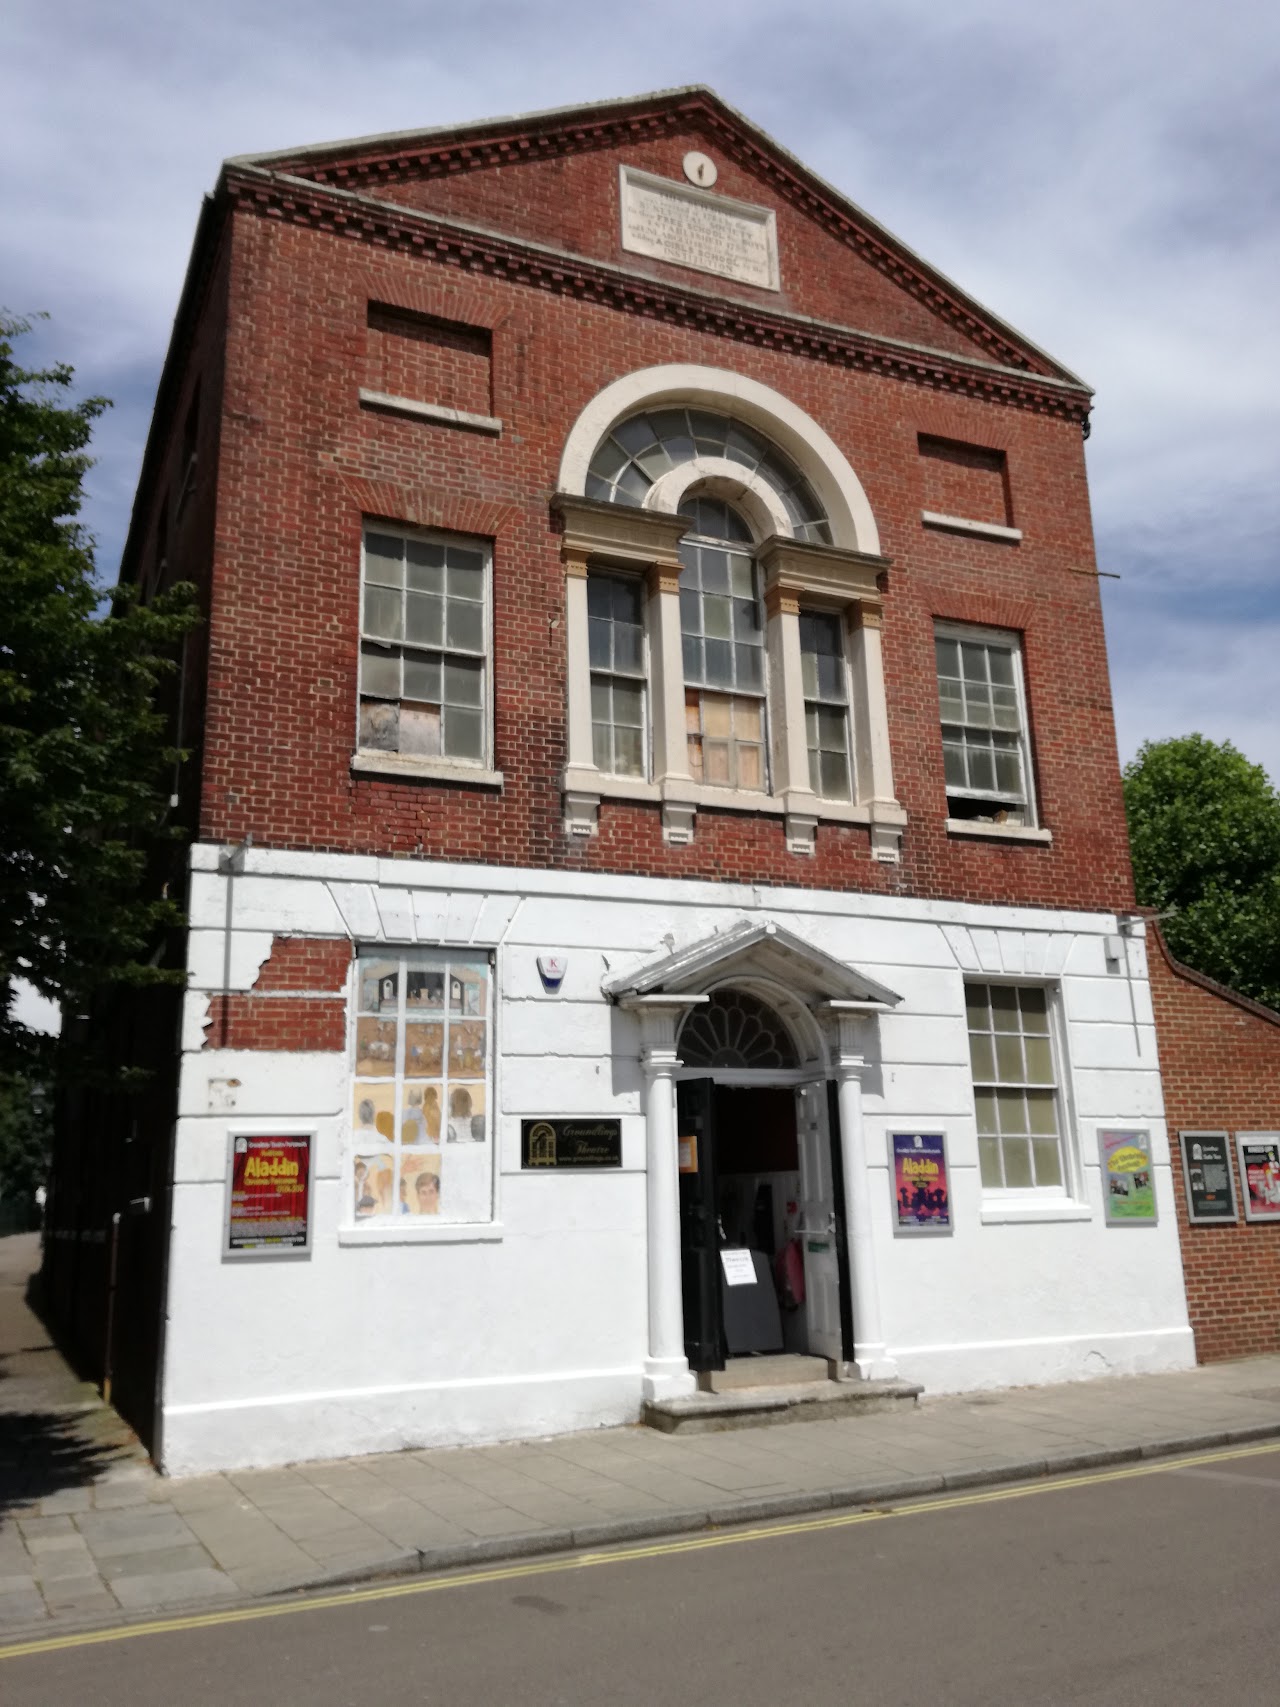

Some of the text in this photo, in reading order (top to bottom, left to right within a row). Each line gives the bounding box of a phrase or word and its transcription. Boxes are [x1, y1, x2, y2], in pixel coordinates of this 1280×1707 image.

[647, 219, 722, 246] ESTABLISHED
[657, 214, 682, 227] FREE
[687, 222, 725, 239] SCHOOL
[664, 239, 693, 254] GIRLS
[698, 249, 739, 267] SCHOOL
[550, 958, 558, 968] K
[562, 1124, 618, 1140] Groundlings
[576, 1140, 609, 1154] Theatre
[244, 1157, 299, 1177] Aladdin
[902, 1157, 939, 1174] Aladdin
